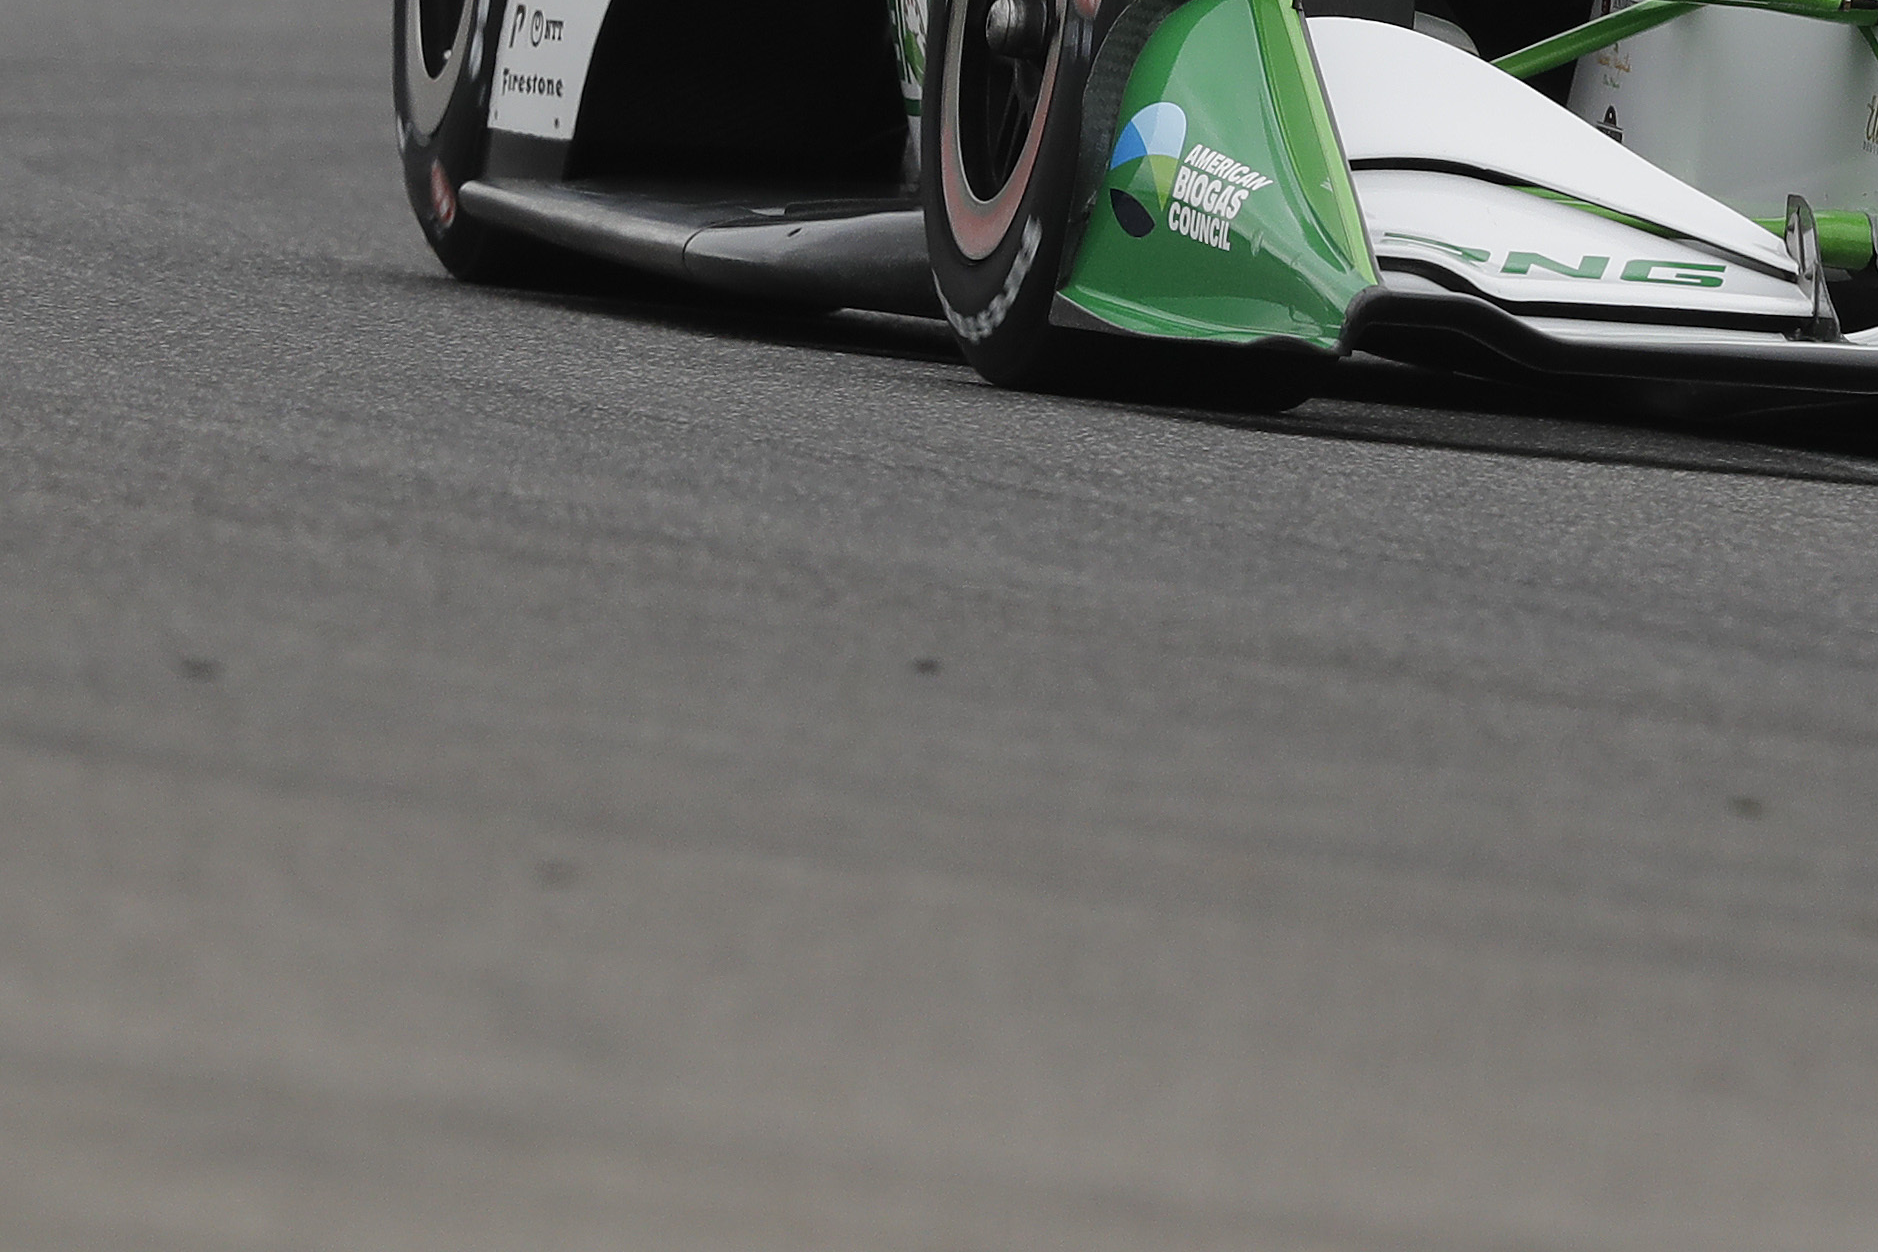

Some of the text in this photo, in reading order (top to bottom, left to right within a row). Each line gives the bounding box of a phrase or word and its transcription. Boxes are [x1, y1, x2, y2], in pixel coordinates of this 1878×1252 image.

[545, 20, 564, 41] NTT
[503, 68, 564, 98] Firestone
[1184, 144, 1274, 191] AMERICAN
[1172, 165, 1250, 220] BIOGAS
[1168, 201, 1231, 252] COUNCIL
[1384, 231, 1728, 289] RNG
